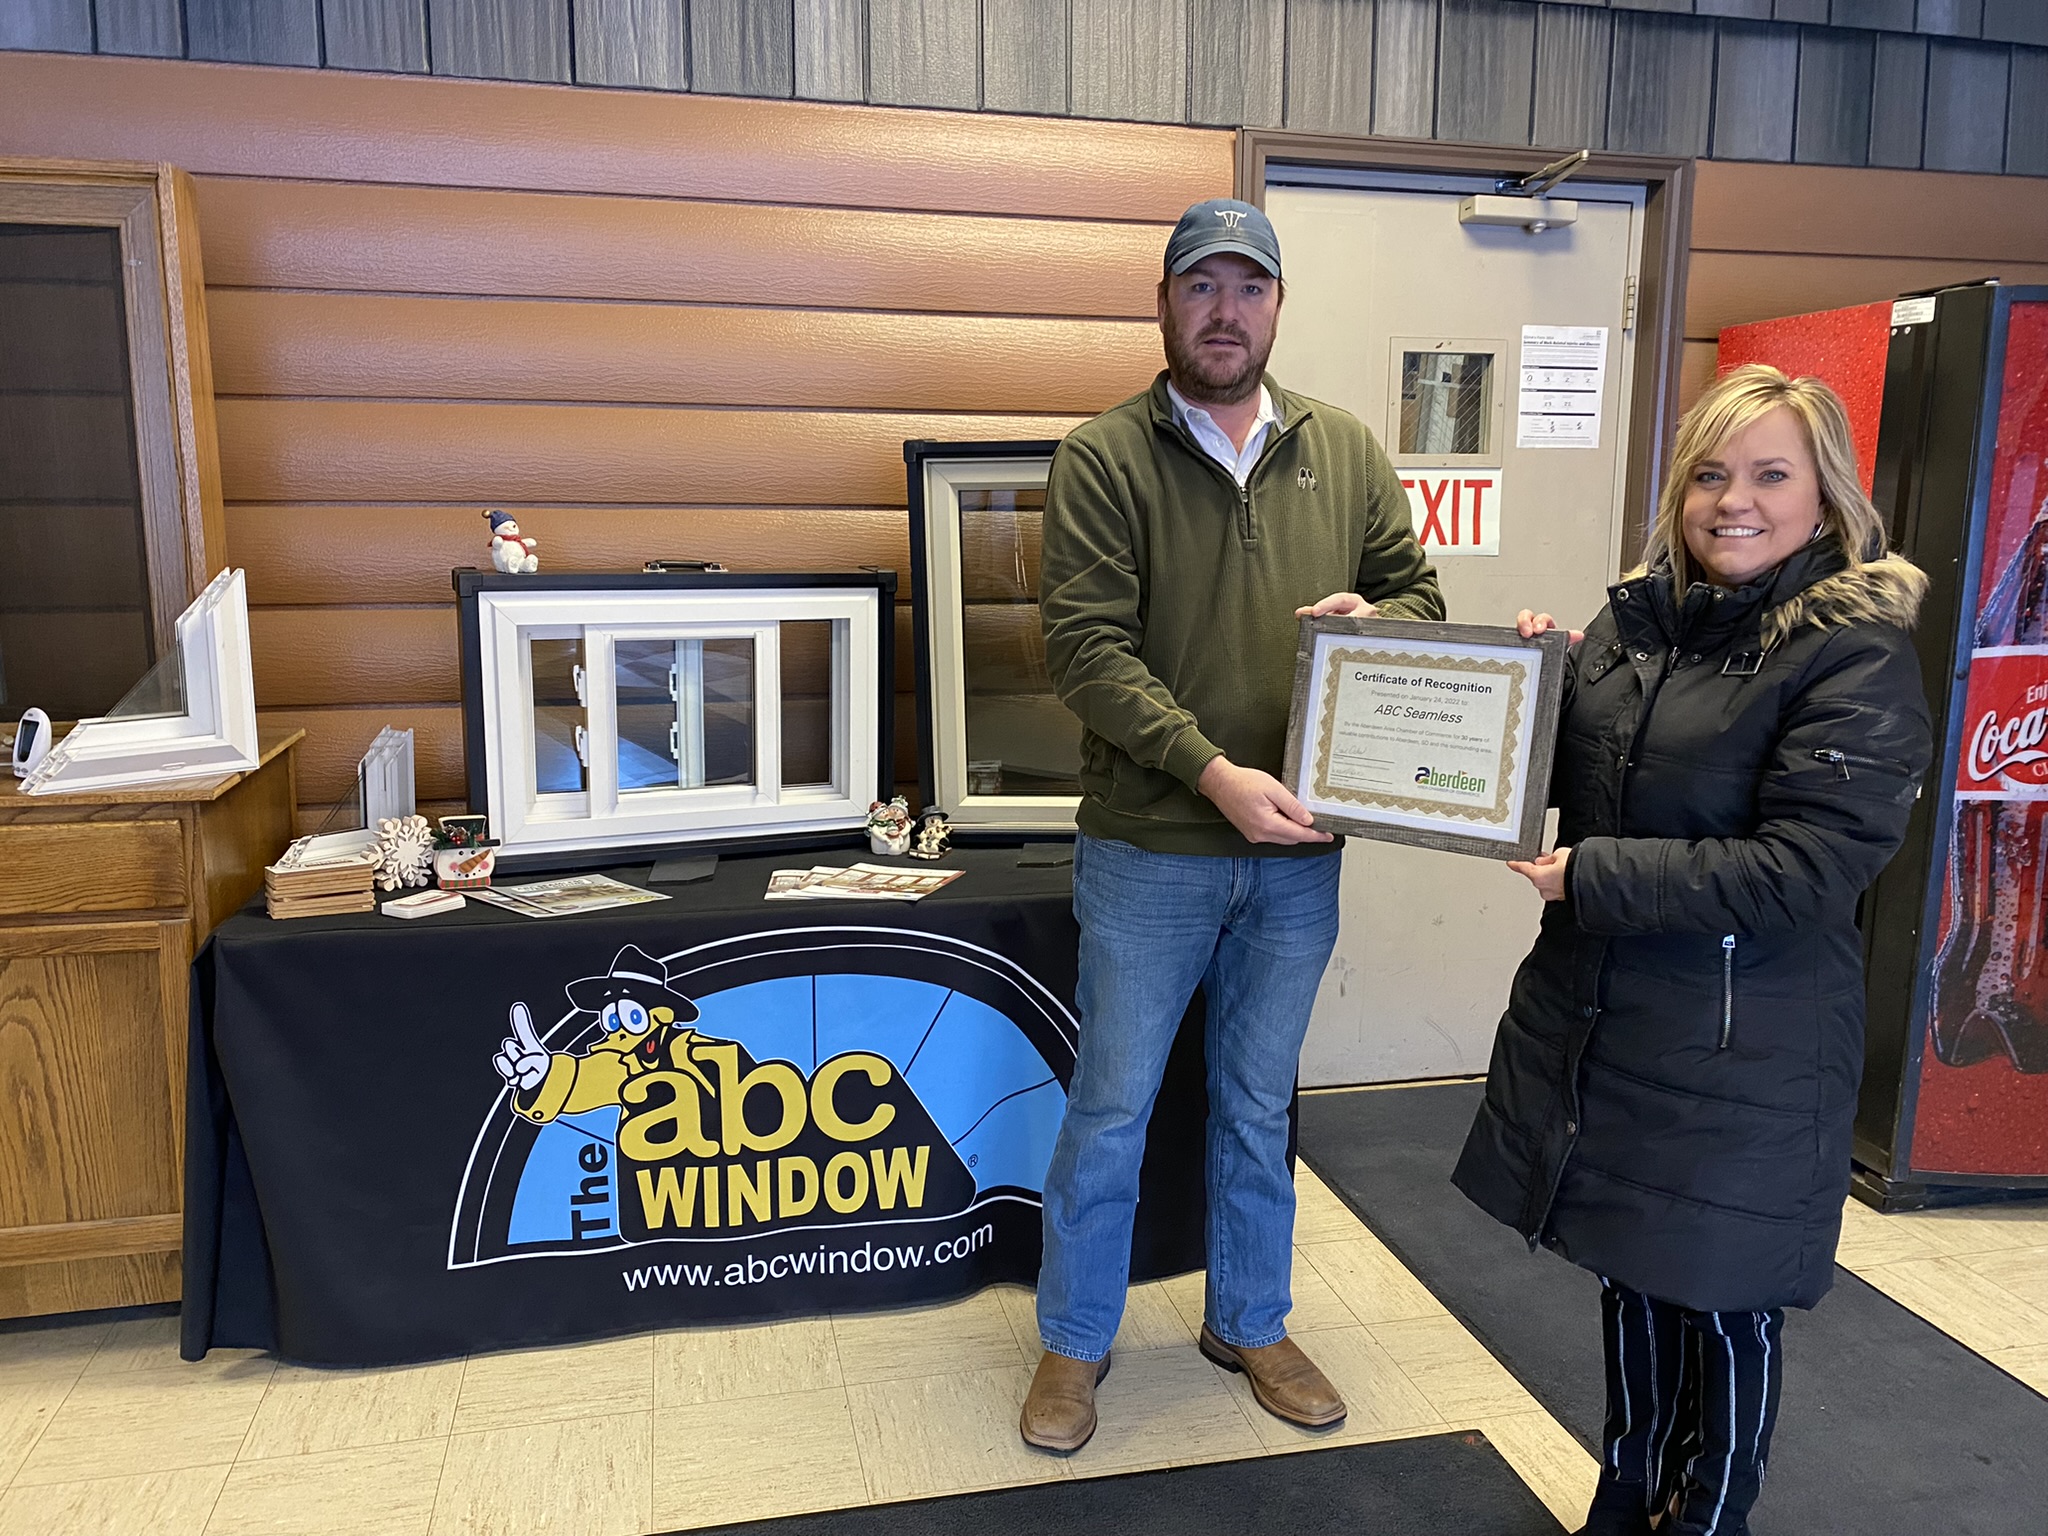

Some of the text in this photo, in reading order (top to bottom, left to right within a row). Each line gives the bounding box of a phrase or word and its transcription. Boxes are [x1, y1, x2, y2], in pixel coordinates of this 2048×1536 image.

[1354, 671, 1492, 694] Certificate of Recognition
[1371, 689, 1400, 699] Presented
[1409, 694, 1432, 703] January
[1433, 696, 1443, 704] 24,
[1444, 697, 1460, 705] 2022
[1374, 703, 1464, 724] ABC Seamless
[1414, 766, 1486, 793] aberdeen
[621, 1043, 897, 1162] abc
[570, 1142, 611, 1241] The
[634, 1144, 931, 1229] WINDOW
[622, 1222, 994, 1293] www.abcwindow.com
